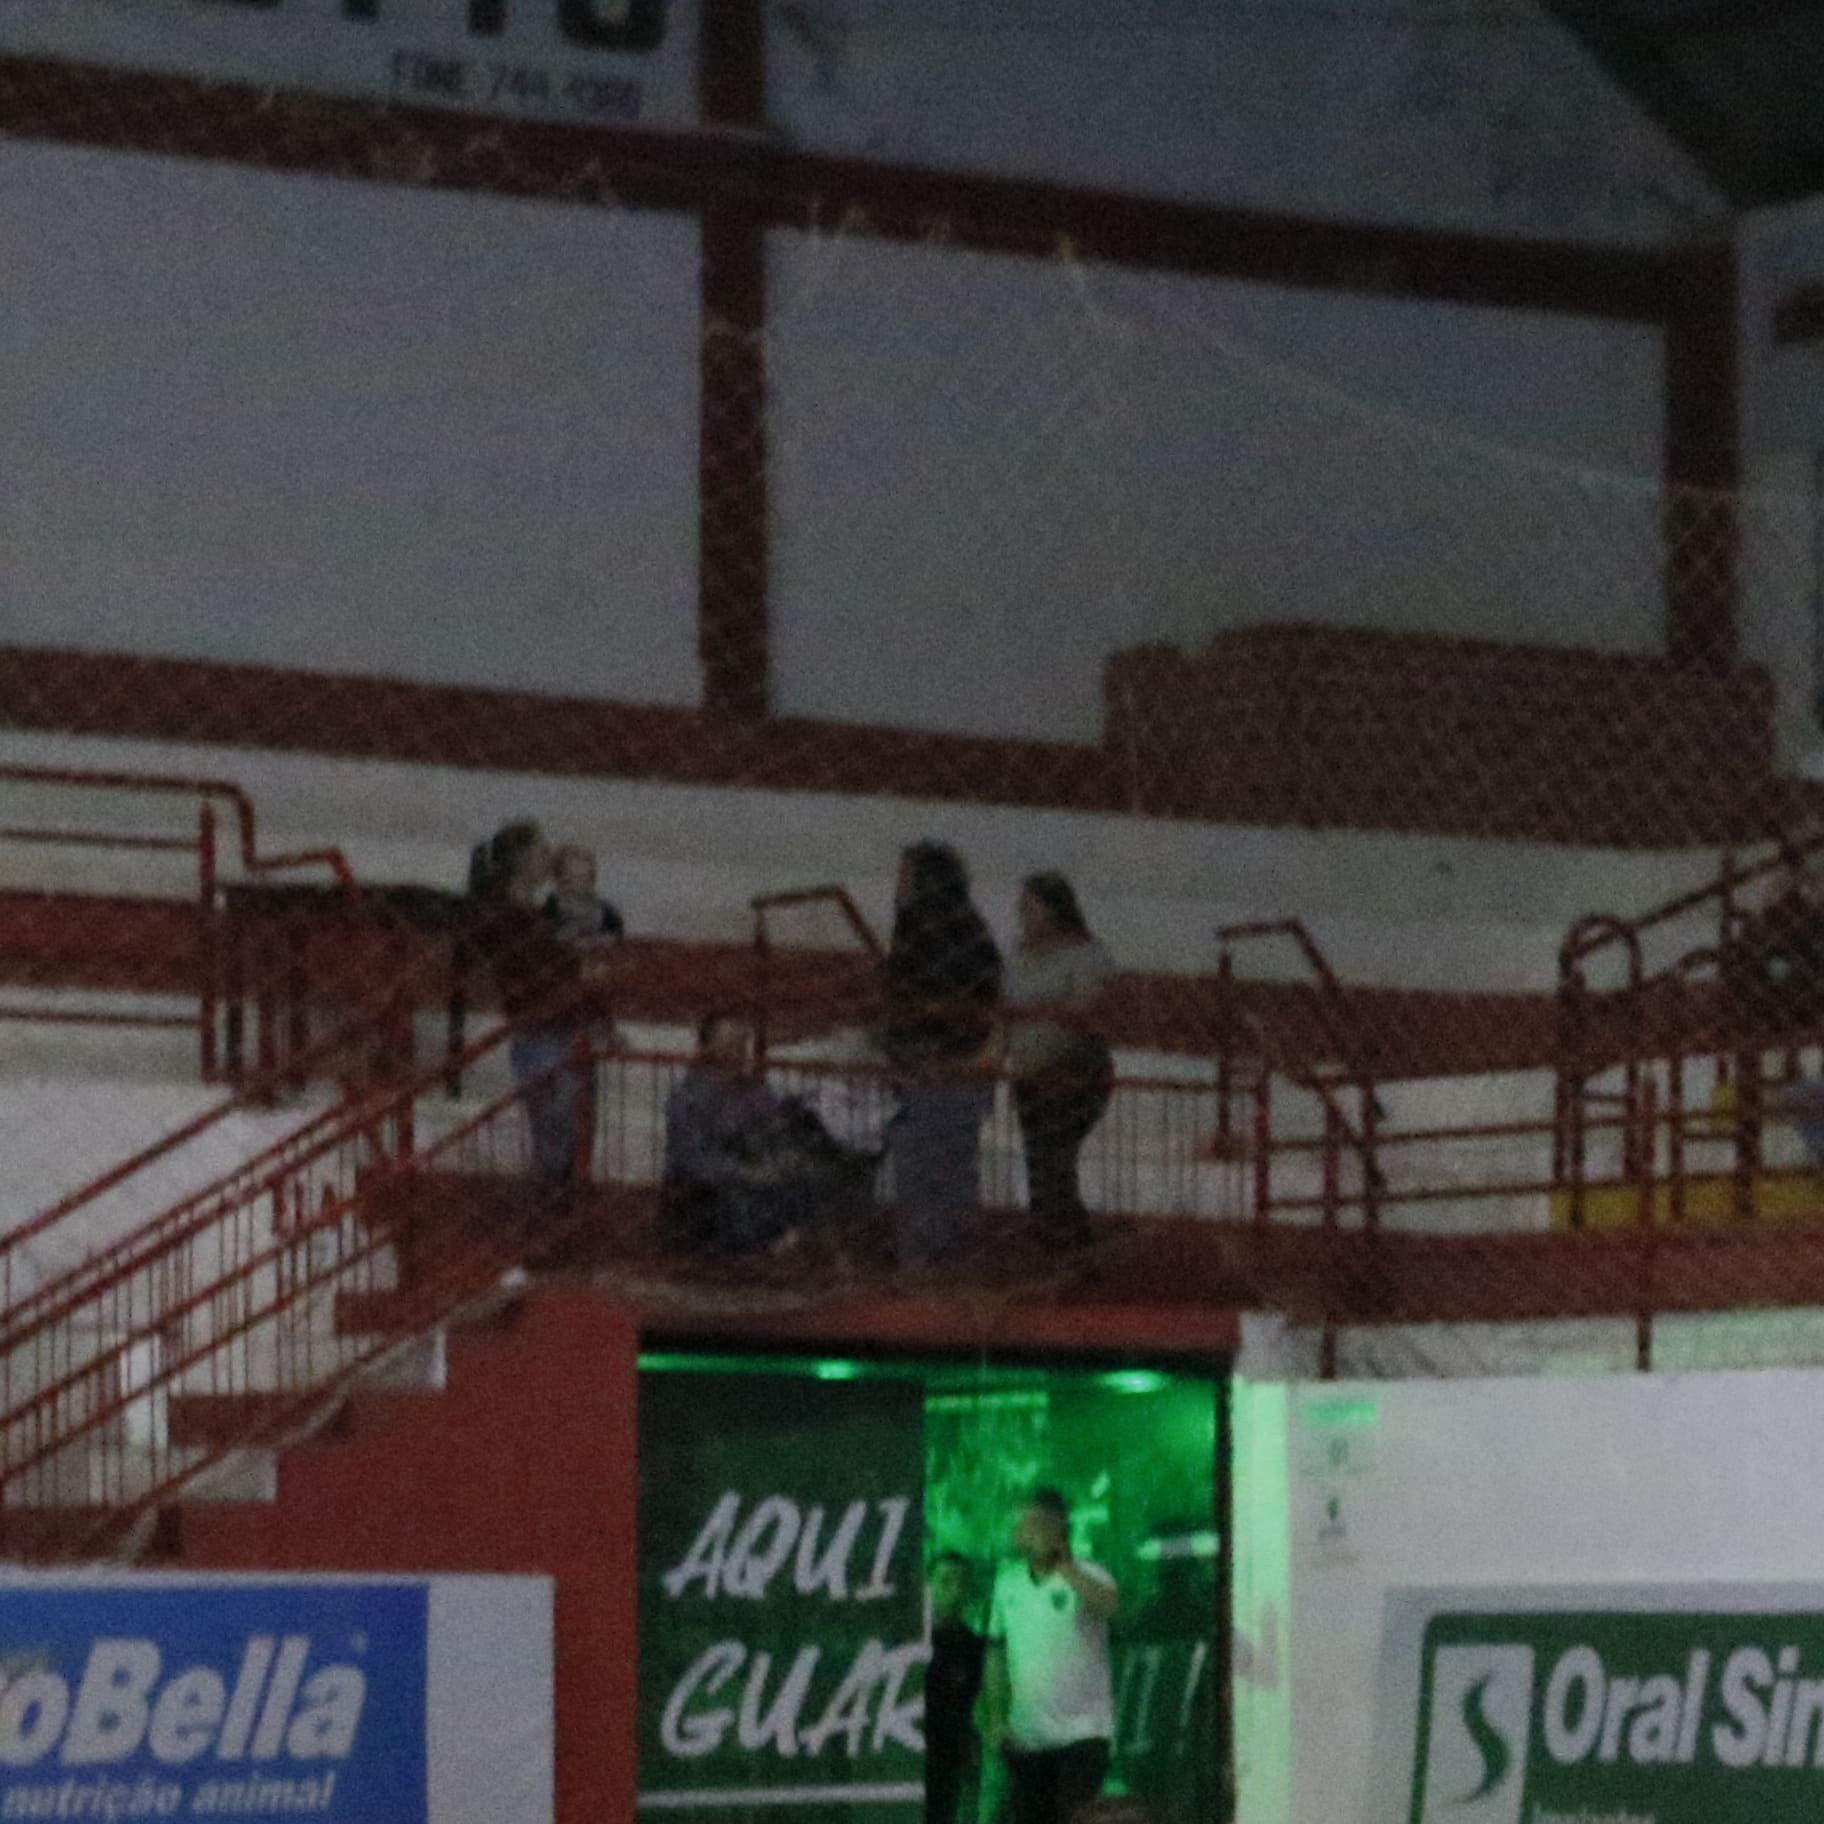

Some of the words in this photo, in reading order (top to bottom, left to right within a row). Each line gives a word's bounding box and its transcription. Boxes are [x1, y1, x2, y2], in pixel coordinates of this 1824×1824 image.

[662, 1490, 910, 1600] AQUI
[0, 1634, 368, 1766] oBella
[1543, 1643, 1712, 1764] Oral
[2, 1774, 184, 1822] nutrição
[192, 1769, 336, 1814] animal
